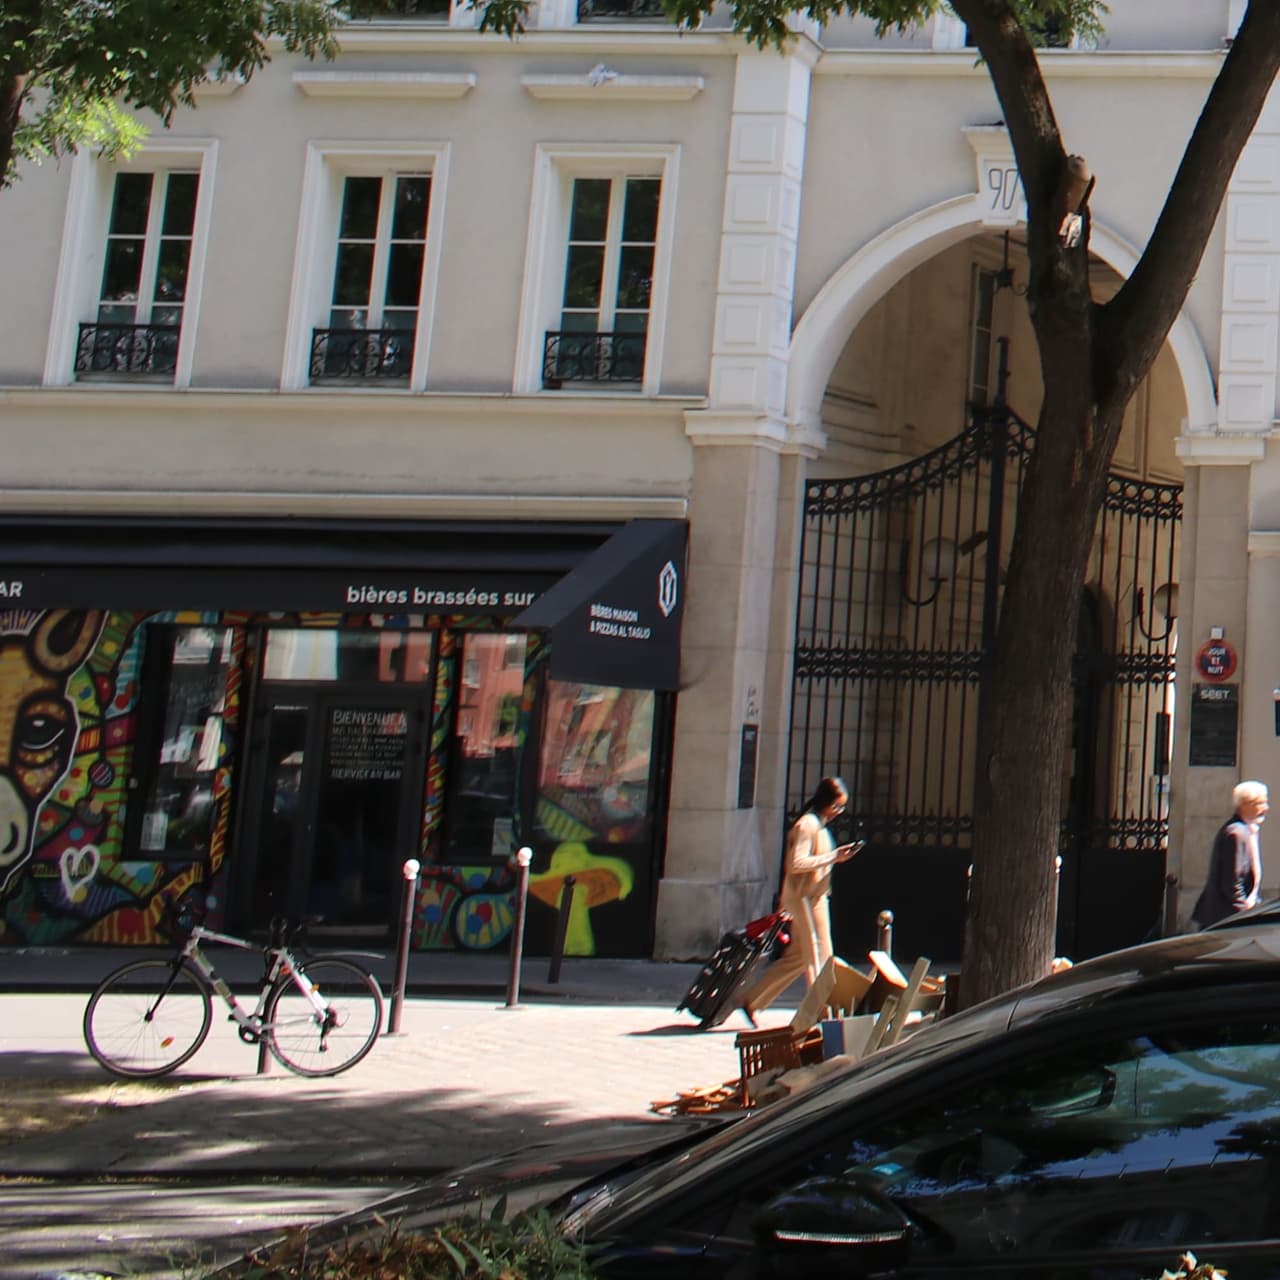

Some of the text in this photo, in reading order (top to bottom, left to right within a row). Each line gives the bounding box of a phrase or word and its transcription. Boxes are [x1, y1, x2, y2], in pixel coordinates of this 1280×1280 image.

[988, 168, 1020, 210] 90
[347, 586, 408, 604] bières
[413, 587, 498, 606] brassées
[504, 592, 535, 606] sur
[613, 607, 638, 622] MAISON
[595, 621, 618, 637] PIZZAS
